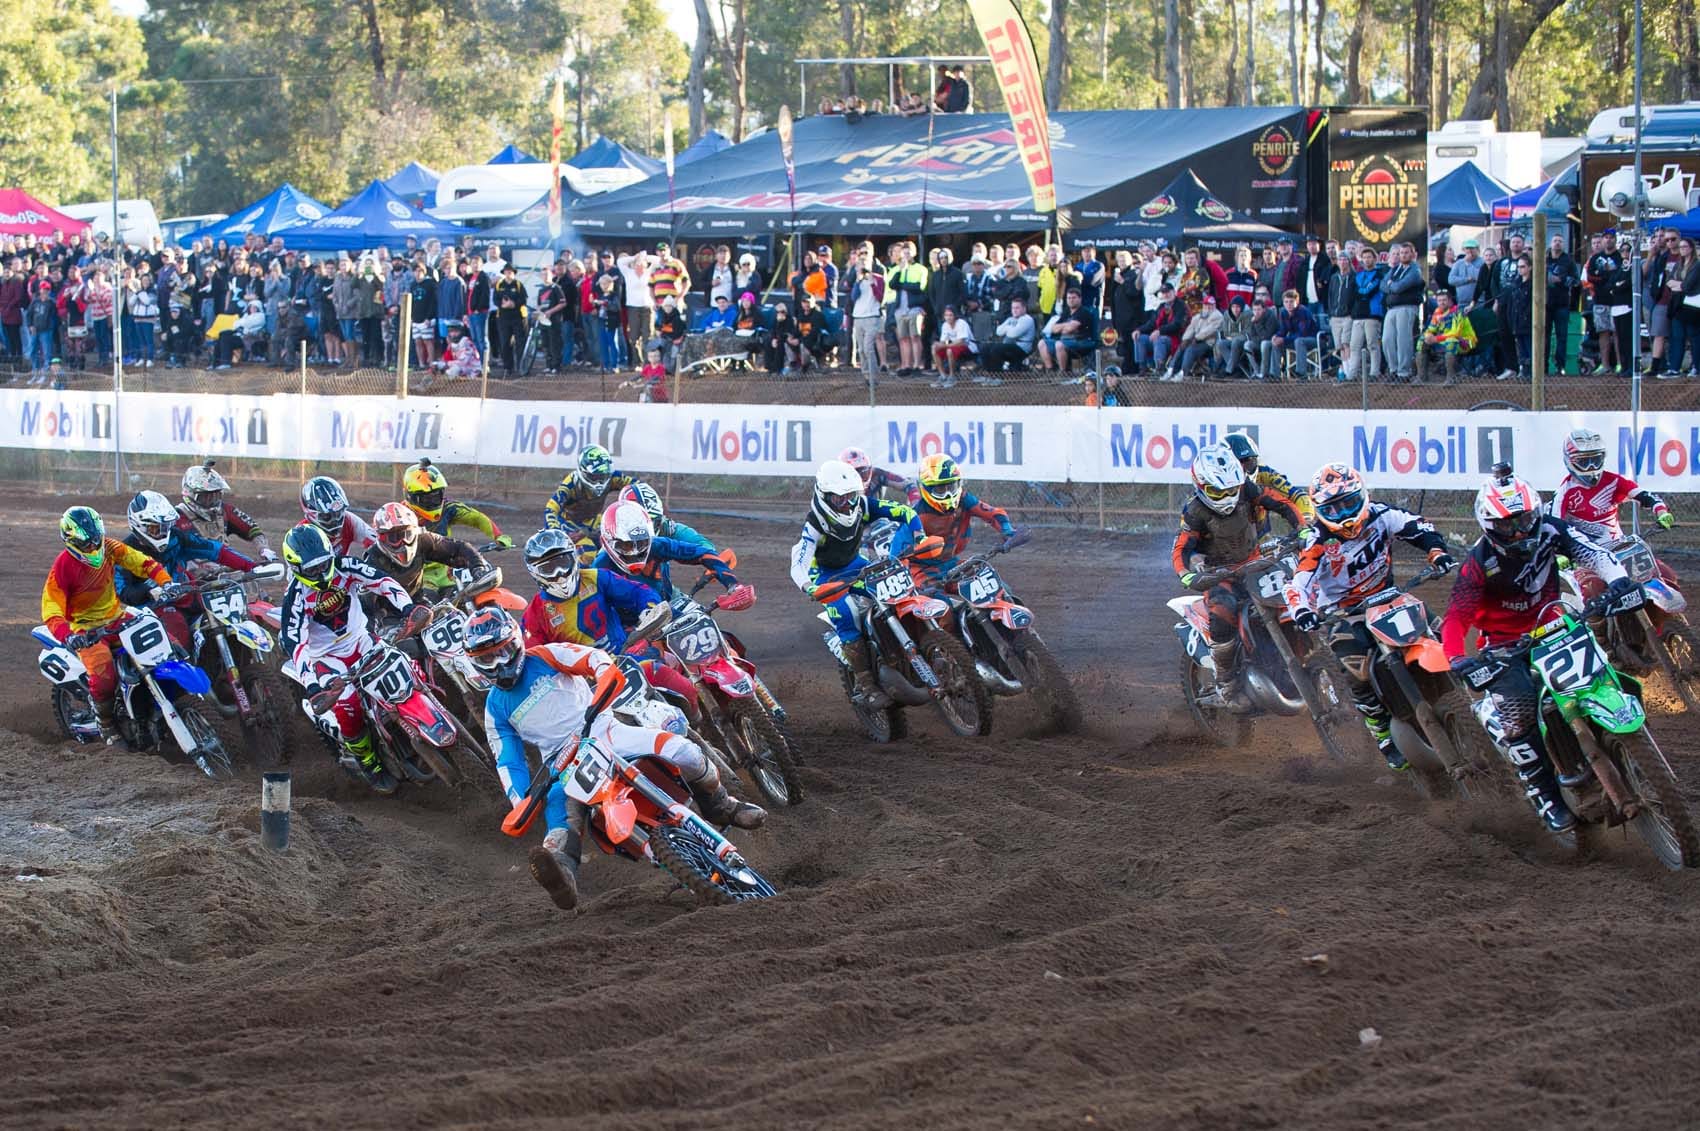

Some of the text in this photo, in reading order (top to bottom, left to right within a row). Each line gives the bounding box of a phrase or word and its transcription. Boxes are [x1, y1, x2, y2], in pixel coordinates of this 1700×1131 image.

[1252, 141, 1300, 157] PENRITE
[1339, 184, 1418, 209] PENRITE
[20, 402, 109, 438] Mobil 1
[250, 409, 265, 444] 1
[420, 414, 438, 448] 1
[511, 414, 622, 456] Mobil 1
[692, 419, 808, 462] Mobil 1
[887, 420, 1018, 465] Mobil 1
[1110, 423, 1217, 469] Mobil
[1353, 425, 1508, 474] Mobil 1
[875, 571, 914, 601] 485
[969, 571, 1000, 602] 45
[210, 592, 244, 620] 54
[1387, 608, 1416, 637] 1
[1501, 600, 1529, 611] MAFIA
[129, 621, 164, 655] 6
[431, 618, 463, 651] 96
[679, 626, 720, 661] 29
[40, 652, 71, 682] 6
[374, 661, 412, 703] 101
[1543, 642, 1596, 691] 27
